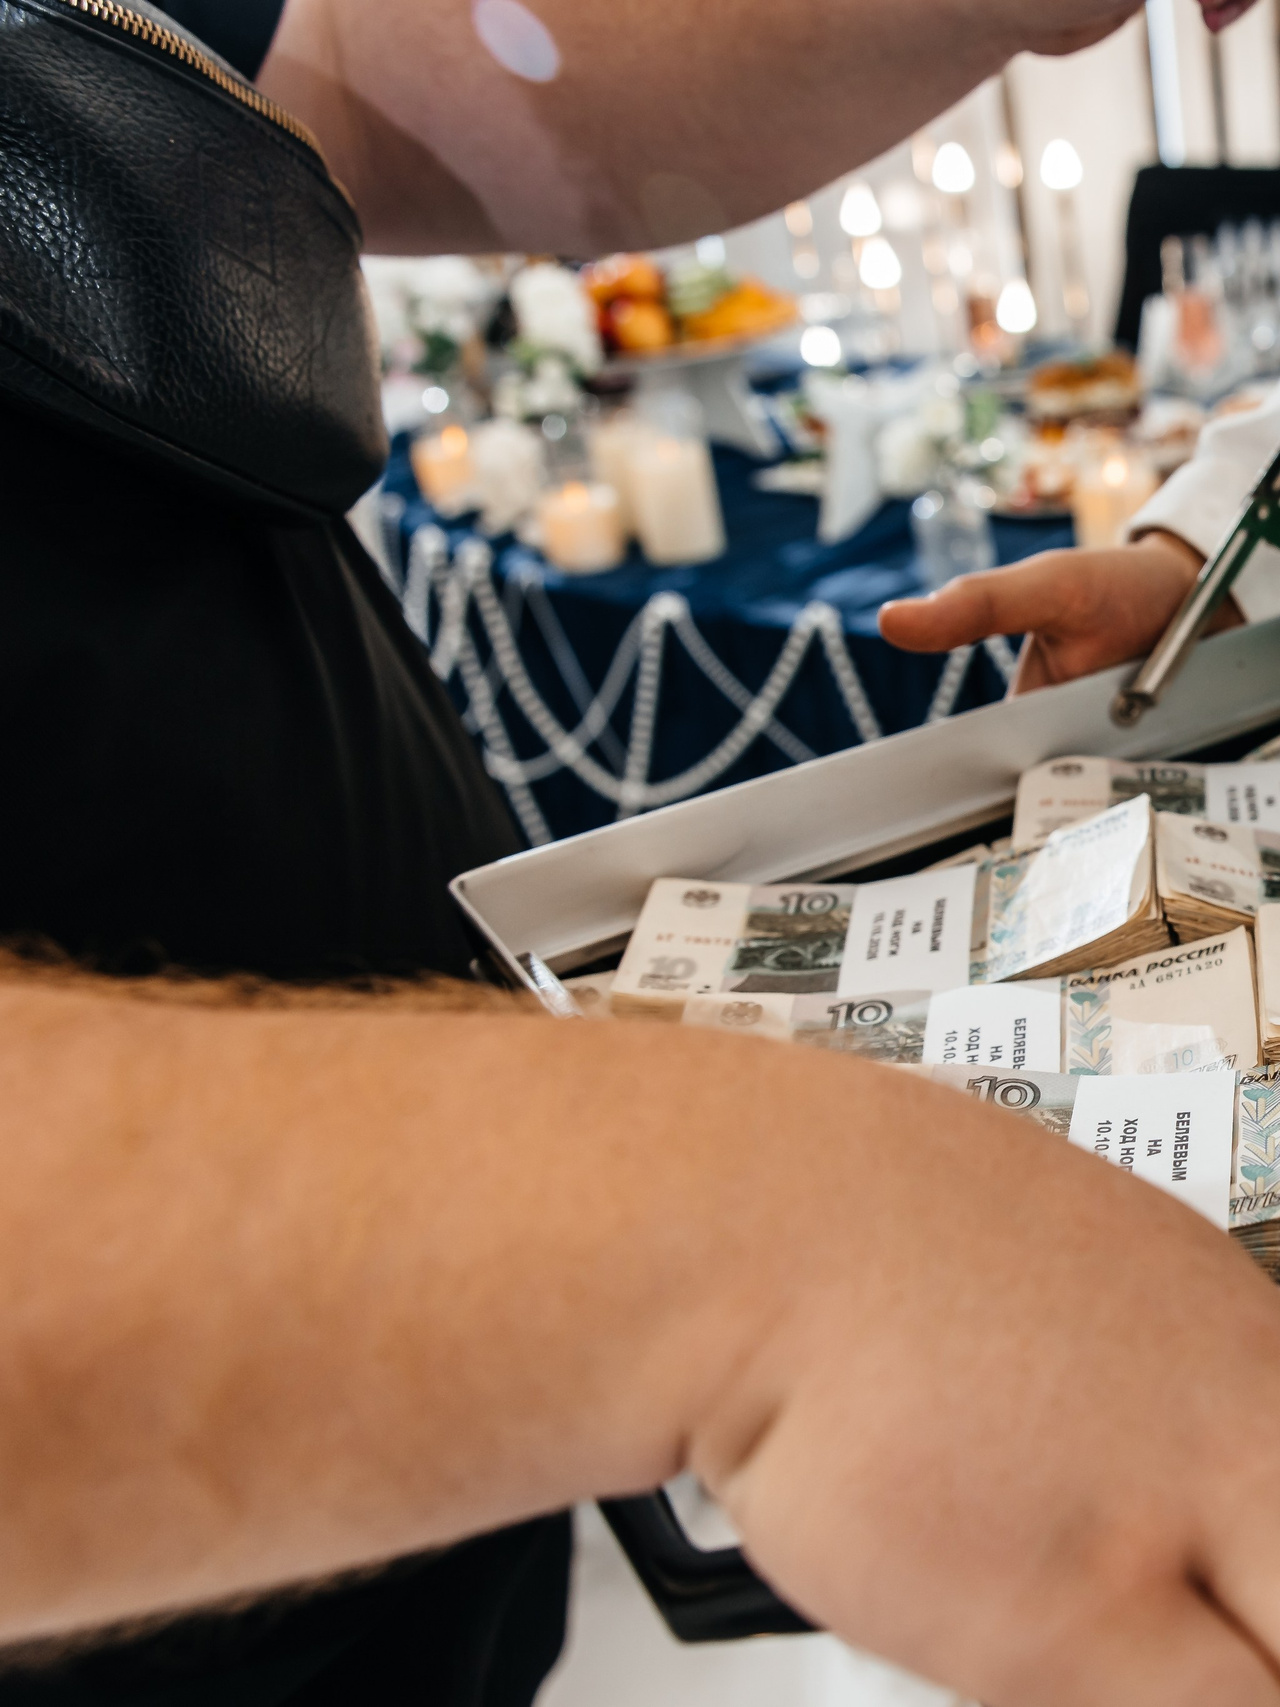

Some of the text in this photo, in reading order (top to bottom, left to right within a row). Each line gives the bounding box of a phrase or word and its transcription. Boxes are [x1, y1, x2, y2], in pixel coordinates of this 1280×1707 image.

[780, 891, 839, 916] 10
[1069, 942, 1228, 988] БАНКА РОССИИ
[1155, 958, 1224, 984] 6871420
[827, 999, 894, 1030] 10
[943, 1030, 958, 1064] 10.10.
[965, 1027, 981, 1052] ХОД
[990, 1045, 1003, 1062] НА
[1013, 1017, 1027, 1070] БЕЛЯЕВ
[1172, 1049, 1194, 1070] 10
[966, 1075, 1041, 1110] 10
[1119, 1118, 1138, 1173] ХОД НОГ
[1147, 1139, 1163, 1157] НА
[1172, 1111, 1191, 1182] БЕЛЯЕВЫМ
